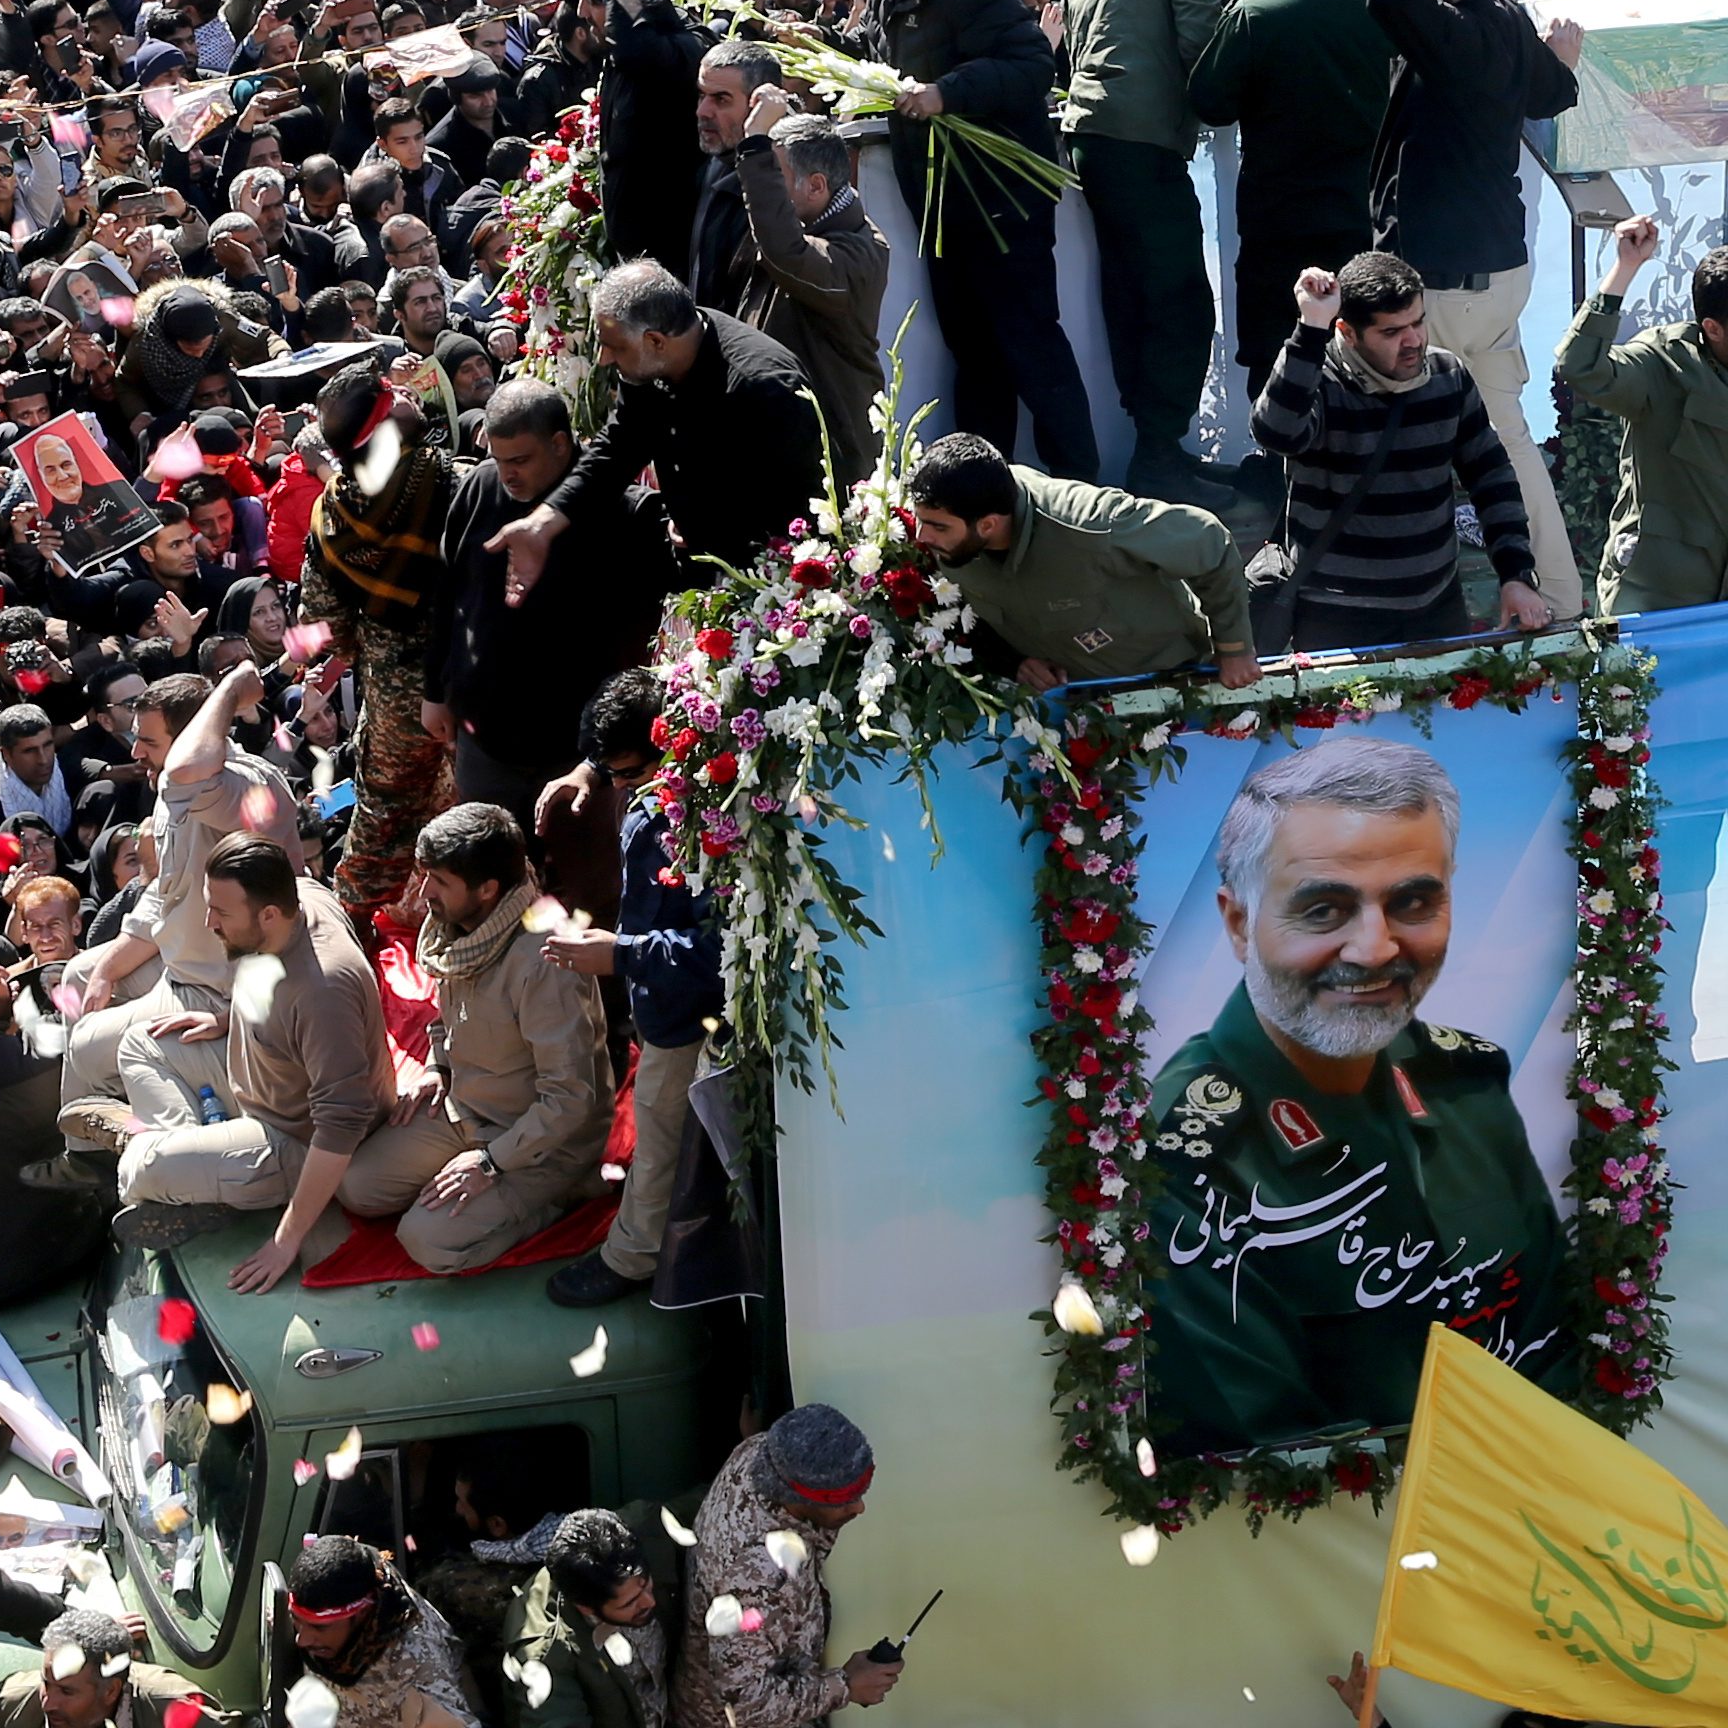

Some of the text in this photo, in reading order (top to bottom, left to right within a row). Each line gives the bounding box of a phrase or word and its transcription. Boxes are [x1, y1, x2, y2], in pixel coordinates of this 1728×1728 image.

[1168, 1161, 1388, 1270] سلیمانی
[1232, 1184, 1388, 1325] قاسم
[1355, 1233, 1435, 1309] حاج
[1406, 1242, 1504, 1311] سپهبد
